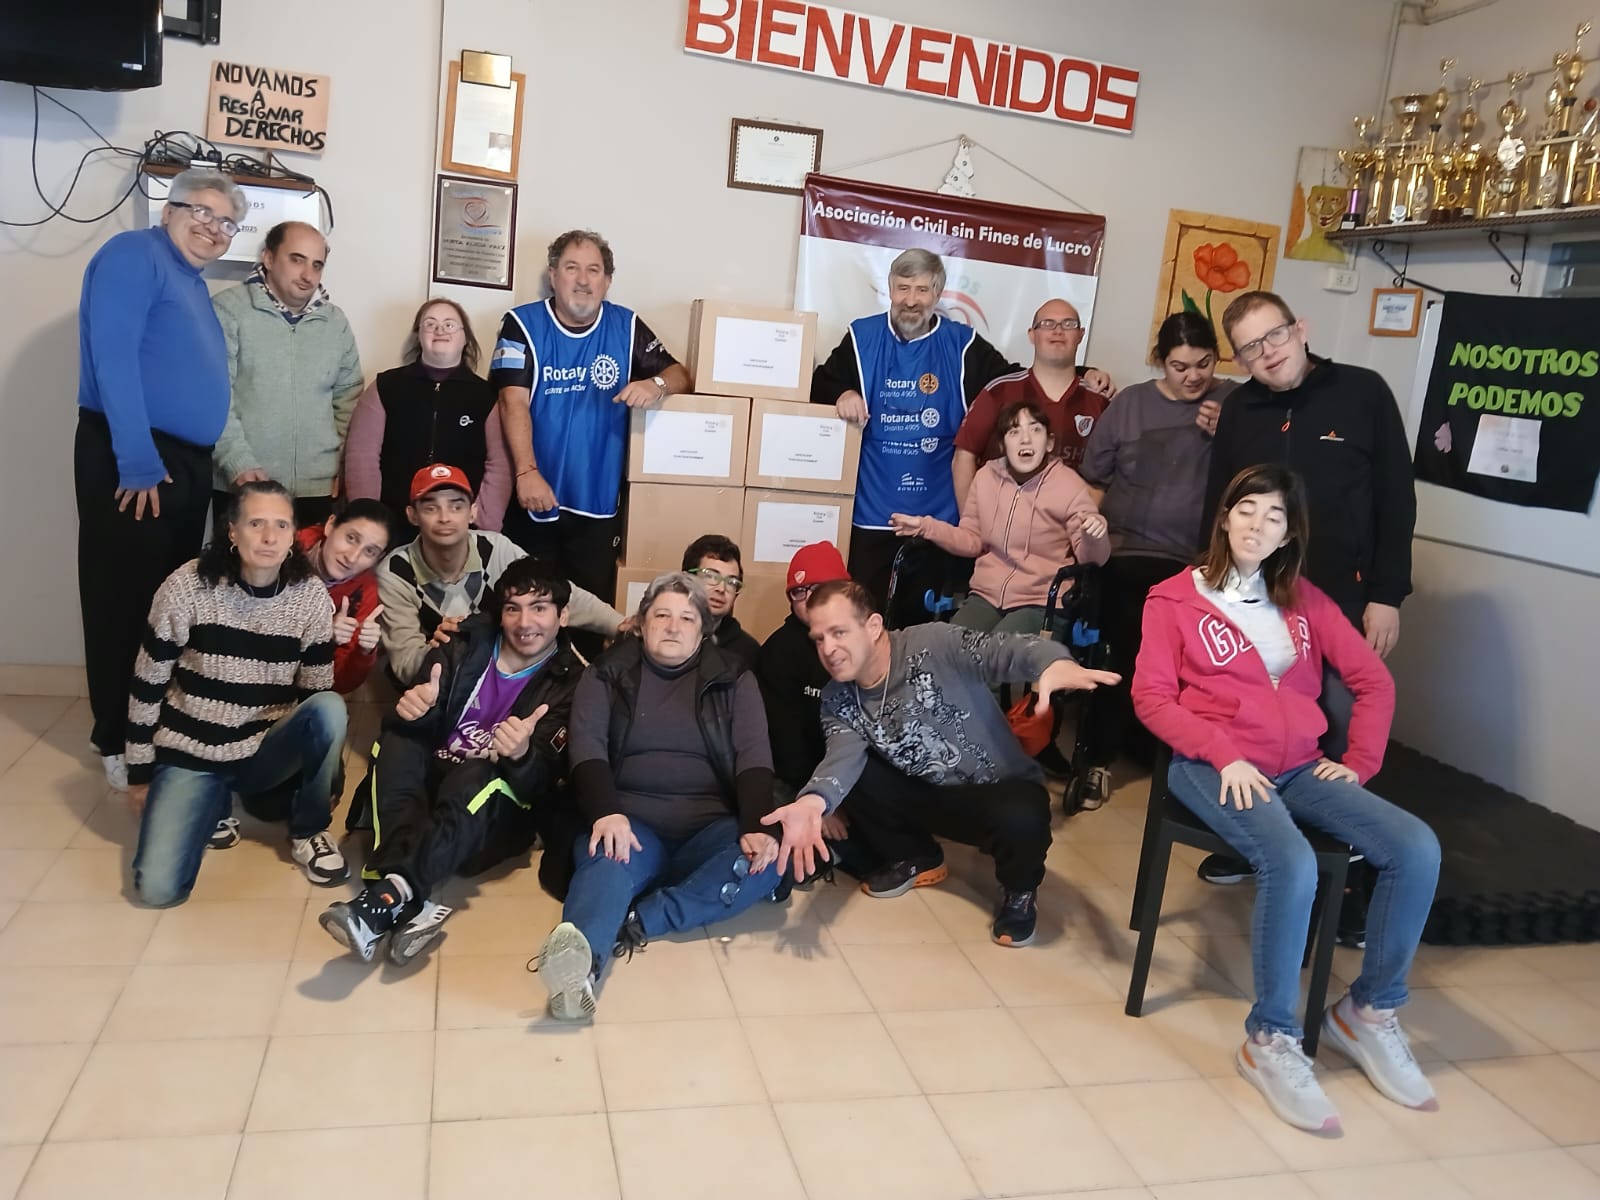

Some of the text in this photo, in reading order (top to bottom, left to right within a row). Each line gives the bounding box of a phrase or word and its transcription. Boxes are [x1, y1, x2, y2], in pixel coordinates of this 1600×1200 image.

[219, 95, 304, 125] RESIGNAR
[251, 89, 266, 109] A
[225, 116, 327, 150] DERECHOS
[812, 200, 1092, 257] Asociación Civil sin Fines de Lucro
[1449, 341, 1600, 377] NOSOTROS
[884, 378, 917, 390] Rotary
[1447, 382, 1585, 418] PODEMOS
[880, 413, 919, 424] Rotaract
